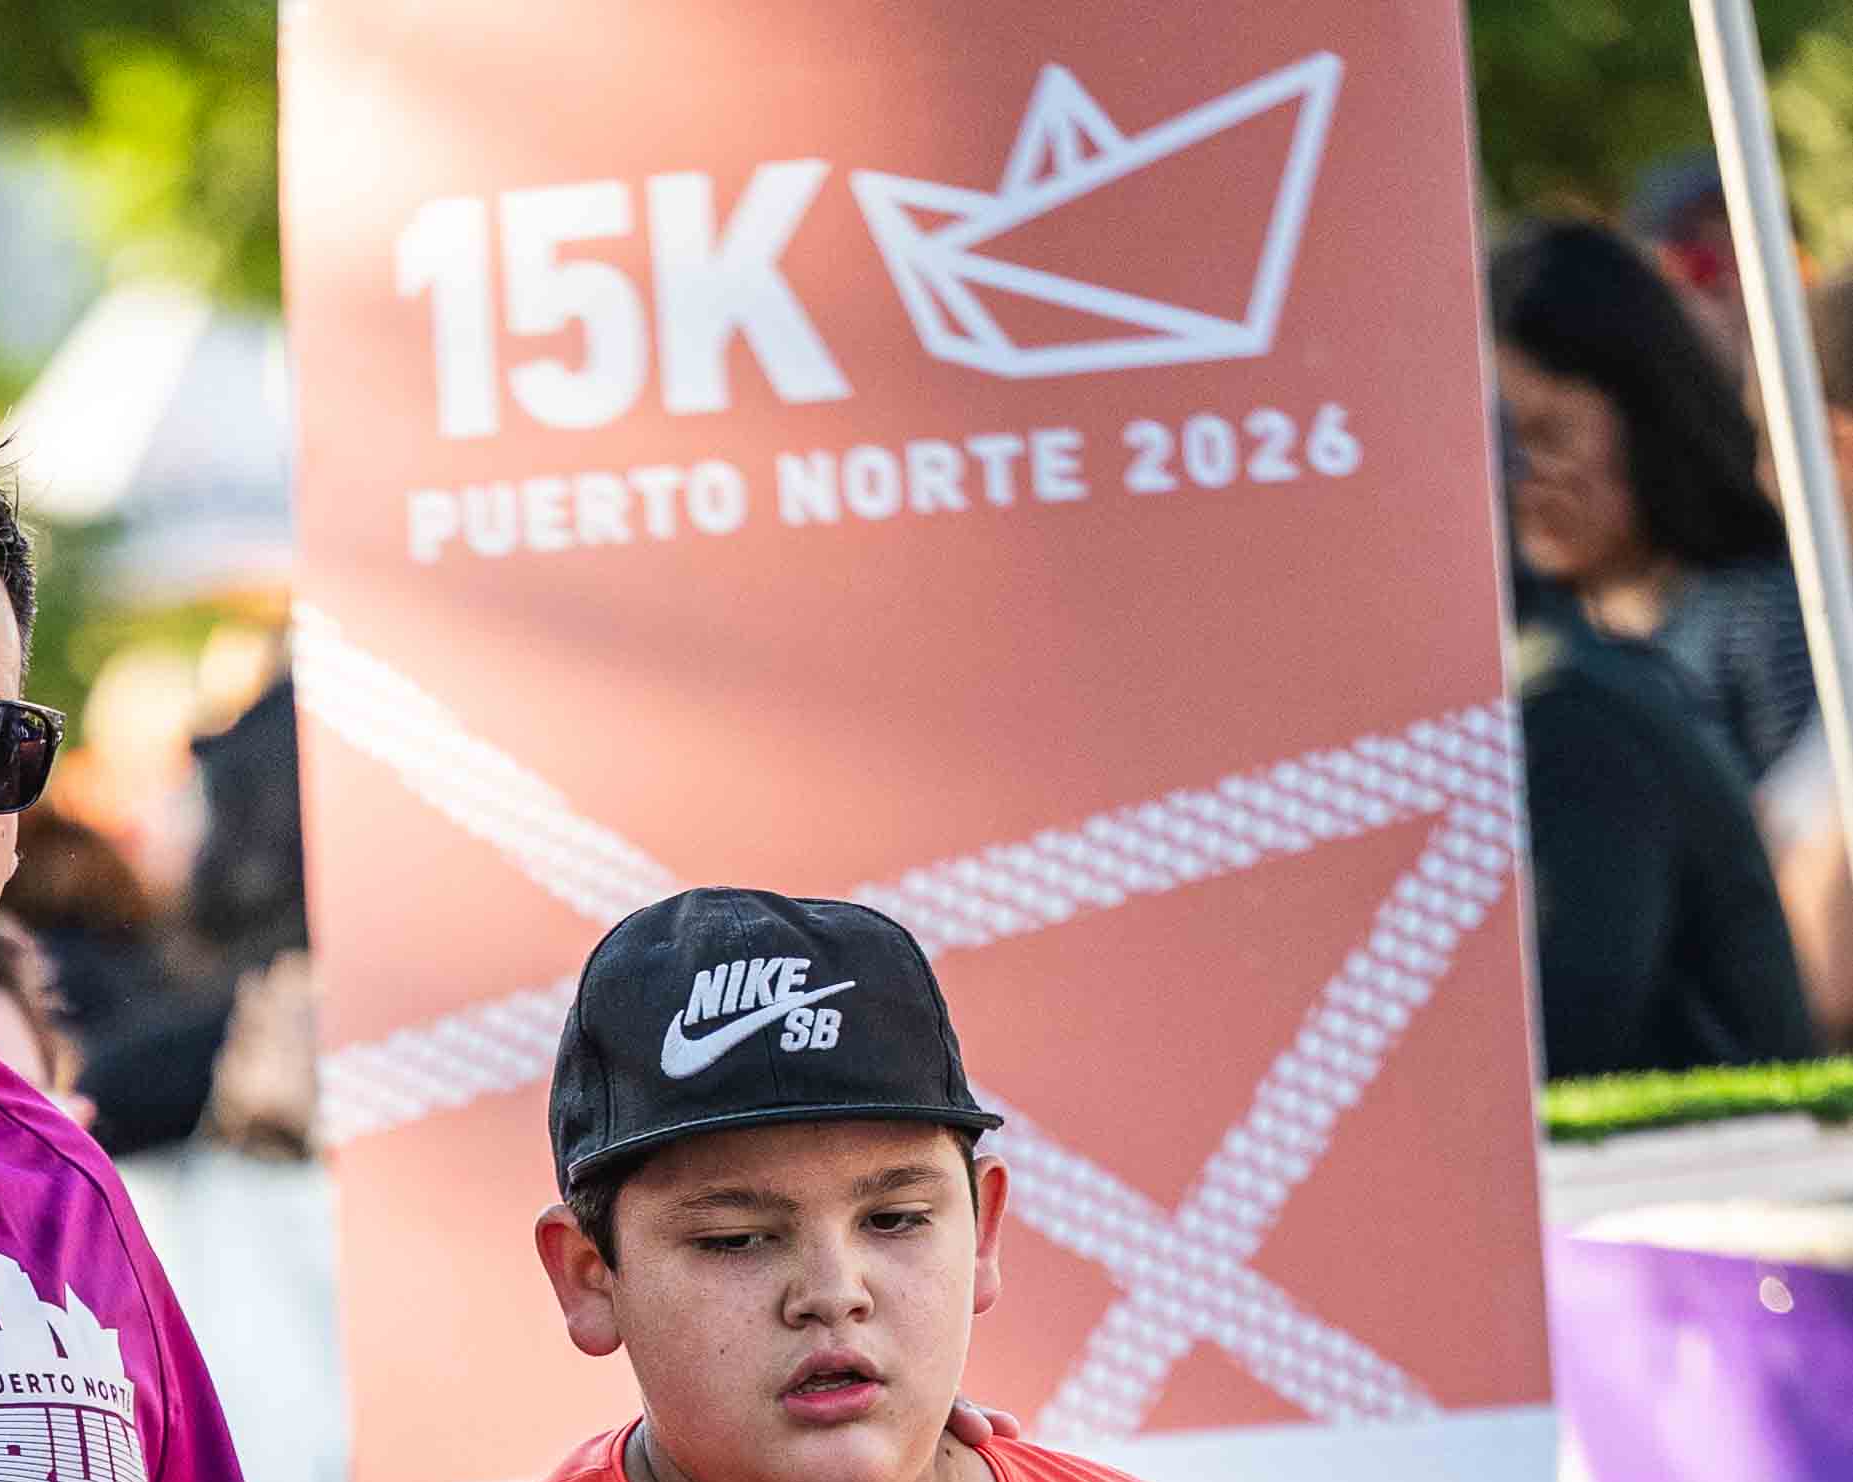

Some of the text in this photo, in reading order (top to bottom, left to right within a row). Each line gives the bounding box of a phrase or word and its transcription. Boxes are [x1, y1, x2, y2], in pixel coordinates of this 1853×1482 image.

[394, 157, 853, 440] 15K
[405, 400, 1364, 566] PUERTO NORTE 2026
[683, 956, 813, 1026] NIKE
[779, 1007, 844, 1052] SB
